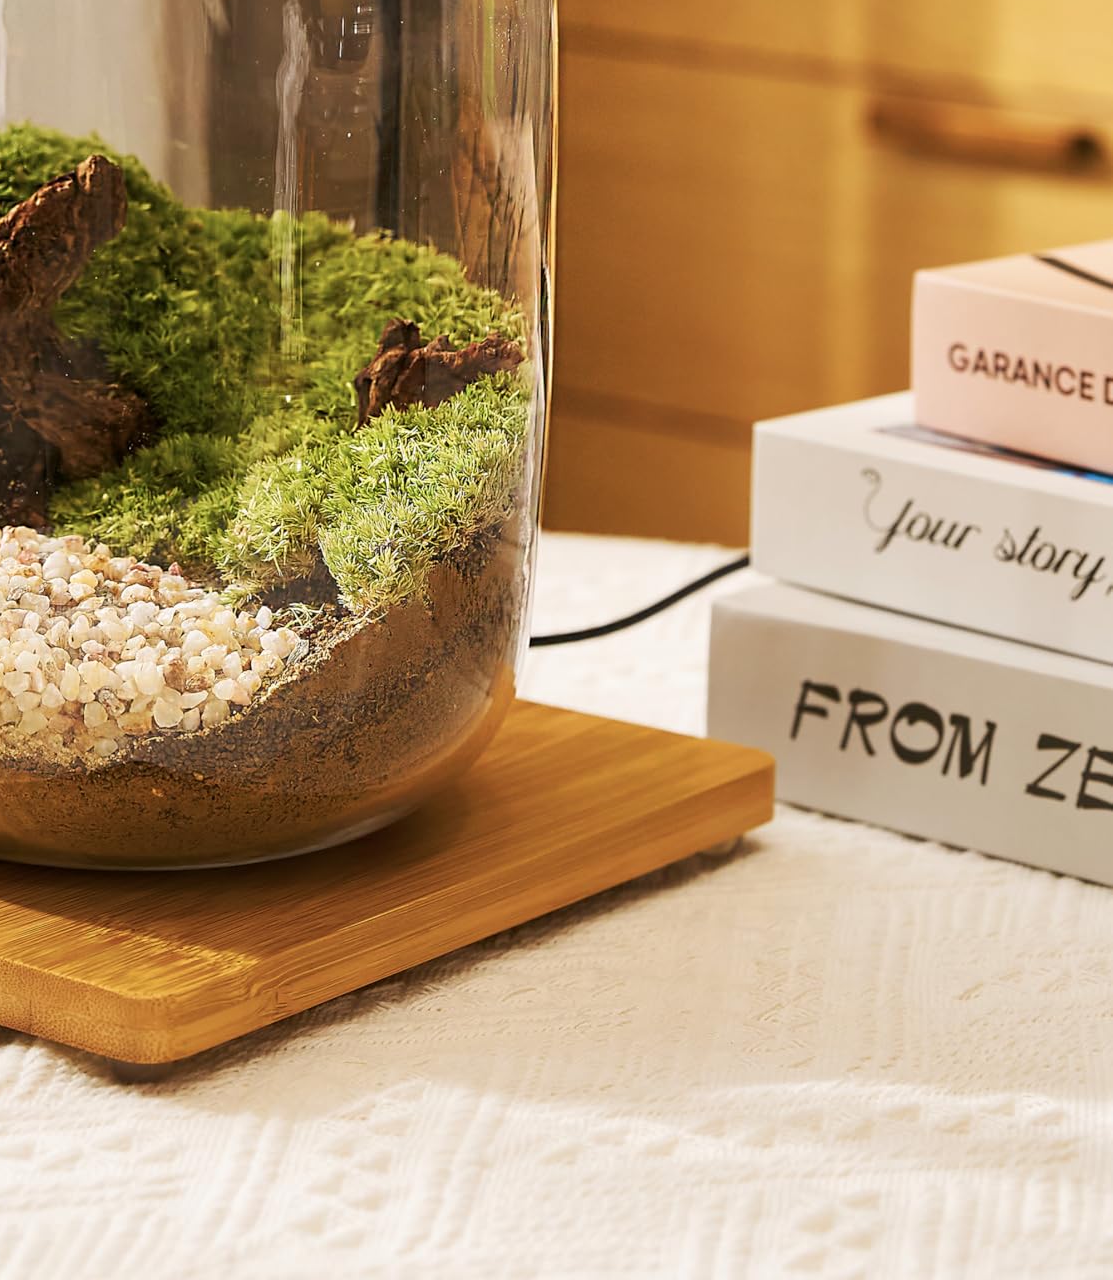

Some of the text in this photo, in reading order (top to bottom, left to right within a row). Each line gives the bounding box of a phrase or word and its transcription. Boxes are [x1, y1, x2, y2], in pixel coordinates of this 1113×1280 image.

[947, 341, 1095, 402] GARANCE
[860, 467, 981, 554] Your
[790, 679, 1113, 811] FROM ZE
